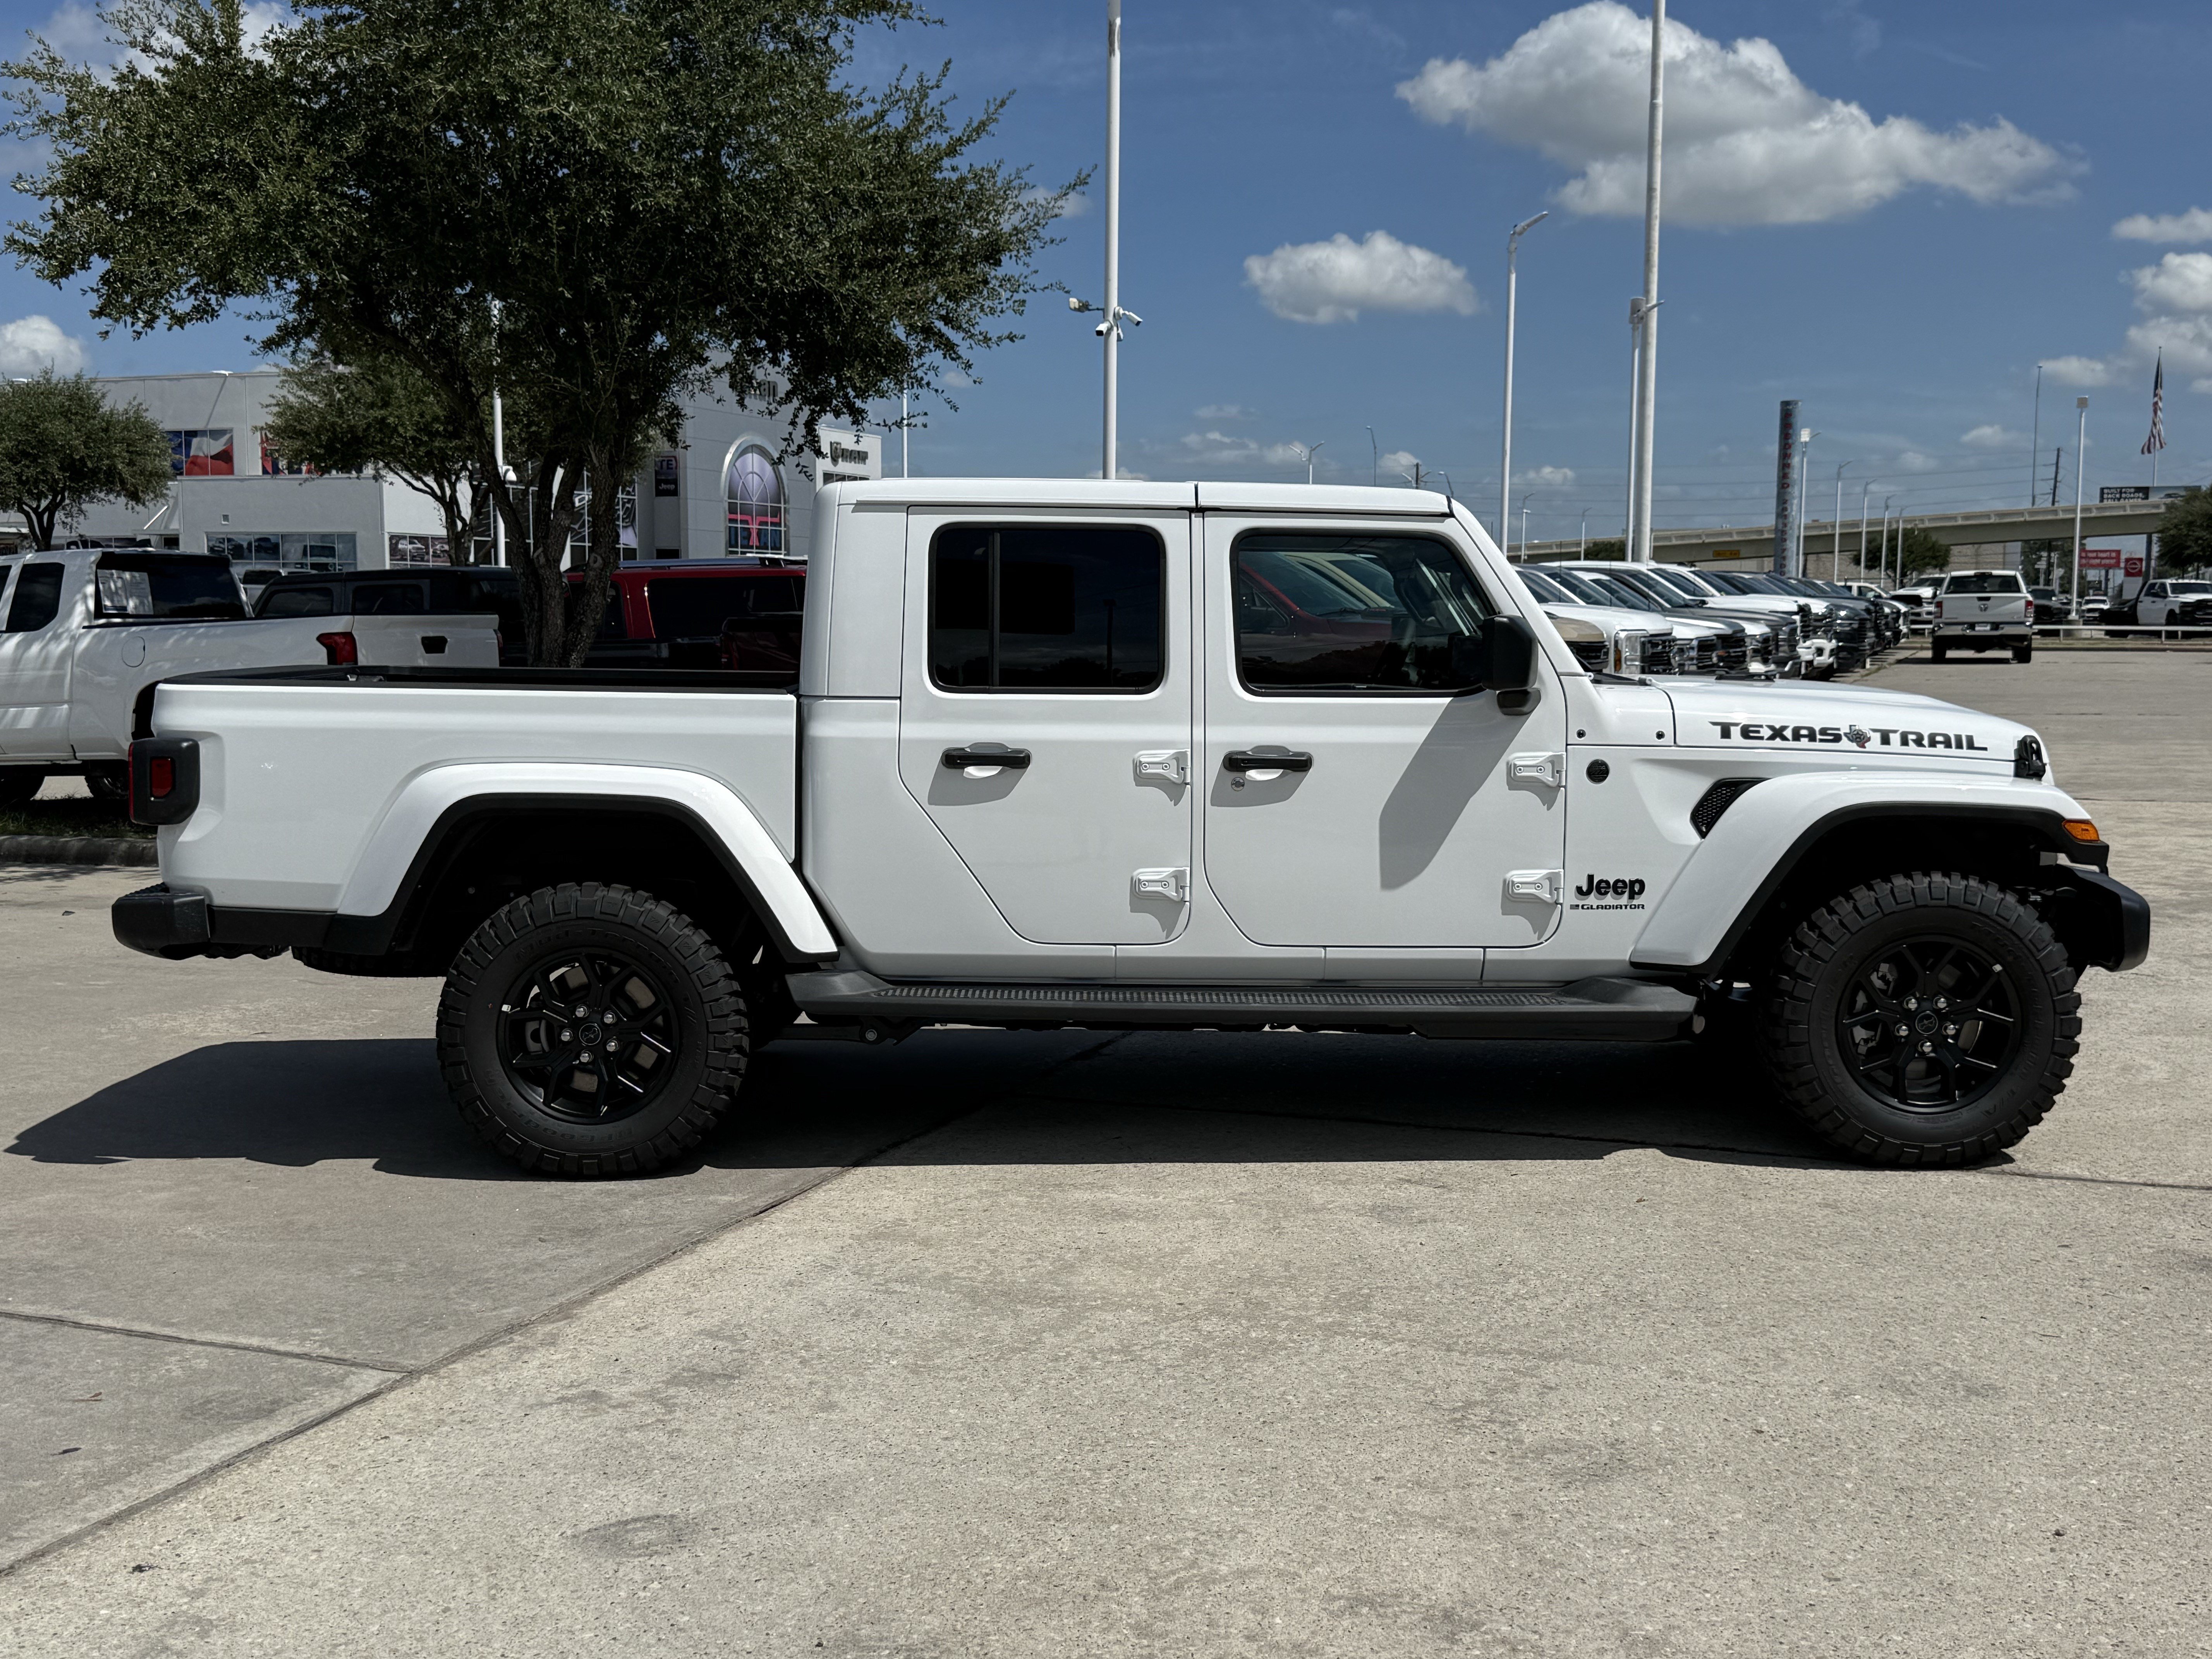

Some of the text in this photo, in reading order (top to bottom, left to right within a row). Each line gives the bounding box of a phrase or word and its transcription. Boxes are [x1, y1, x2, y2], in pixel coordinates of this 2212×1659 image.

[841, 448, 868, 462] RAM
[1708, 721, 1988, 751] TEXAS TRAIL
[1576, 872, 1645, 900] Jeep
